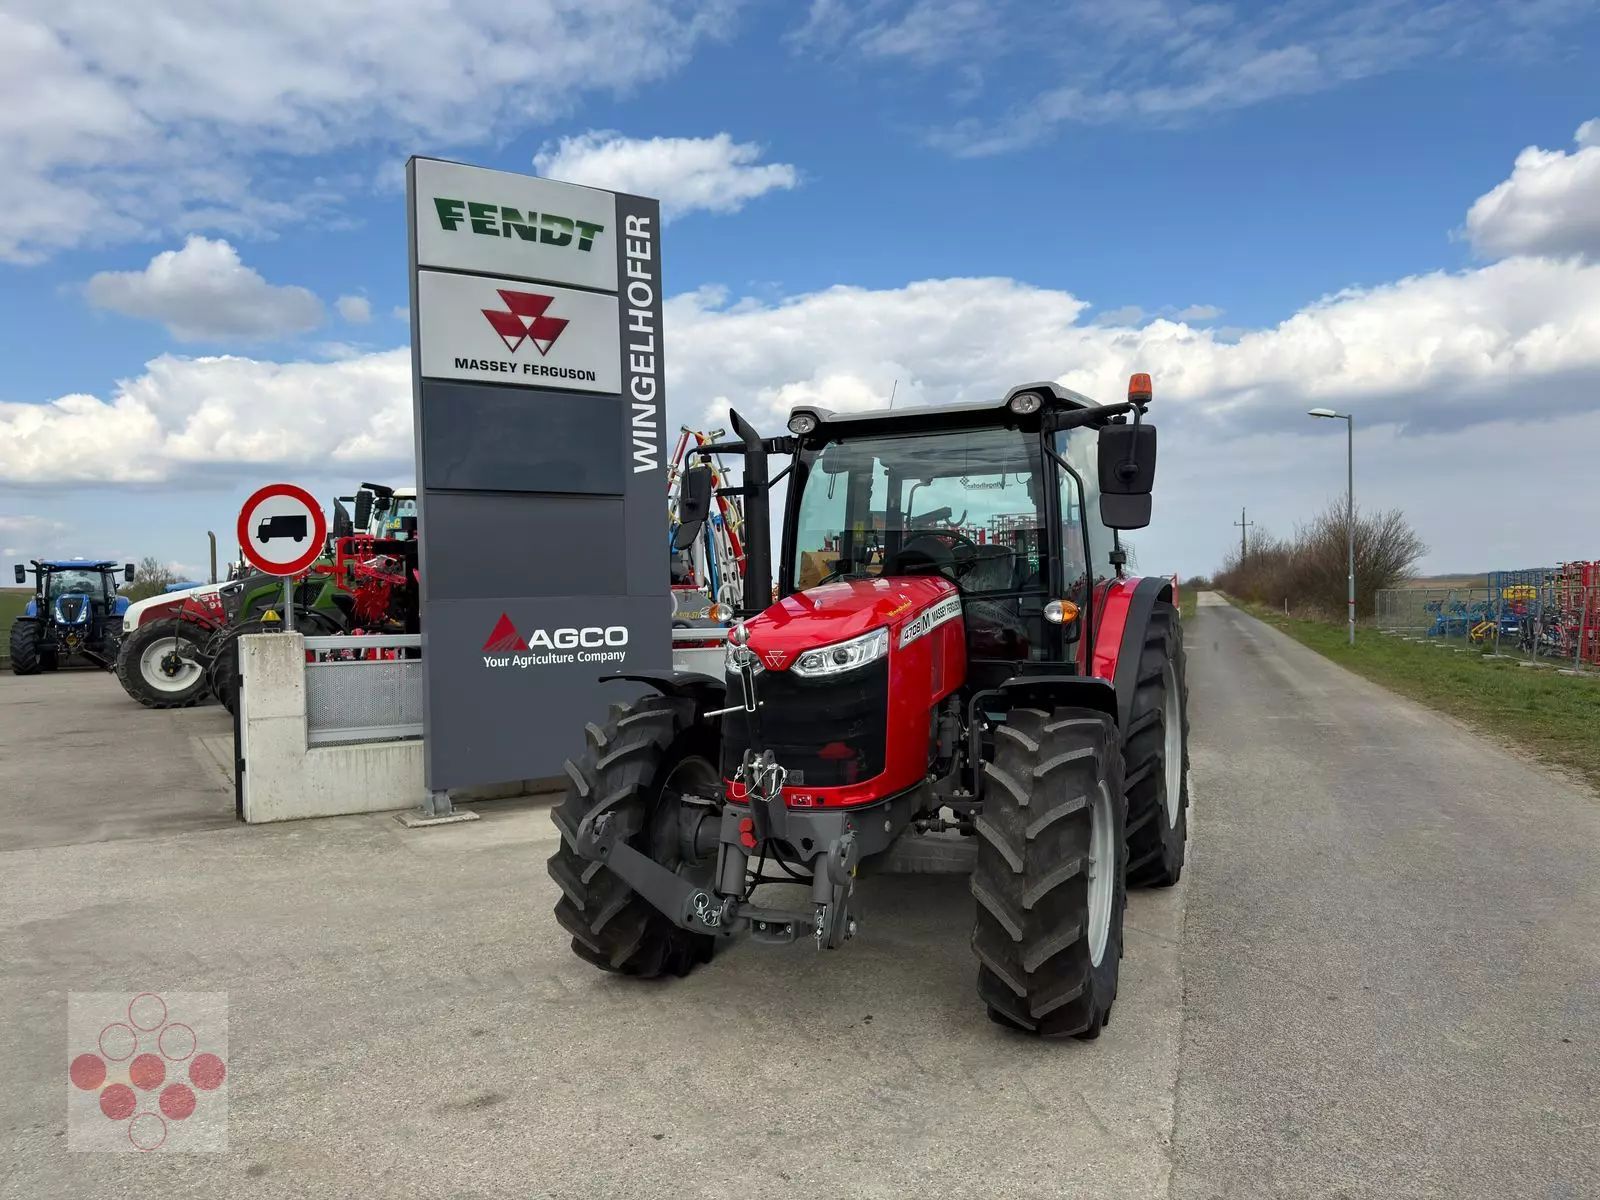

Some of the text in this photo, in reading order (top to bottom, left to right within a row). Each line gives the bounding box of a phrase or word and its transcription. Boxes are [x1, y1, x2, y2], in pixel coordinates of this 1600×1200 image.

[433, 197, 604, 252] FENDT
[625, 214, 659, 474] WINGELHOFER
[454, 357, 596, 382] MASSEY FERGUSON
[903, 621, 921, 640] 4708
[921, 612, 931, 631] M
[931, 604, 946, 623] MASSEY
[528, 626, 629, 650] AGCO
[483, 651, 626, 668] Your Agriculture Company
